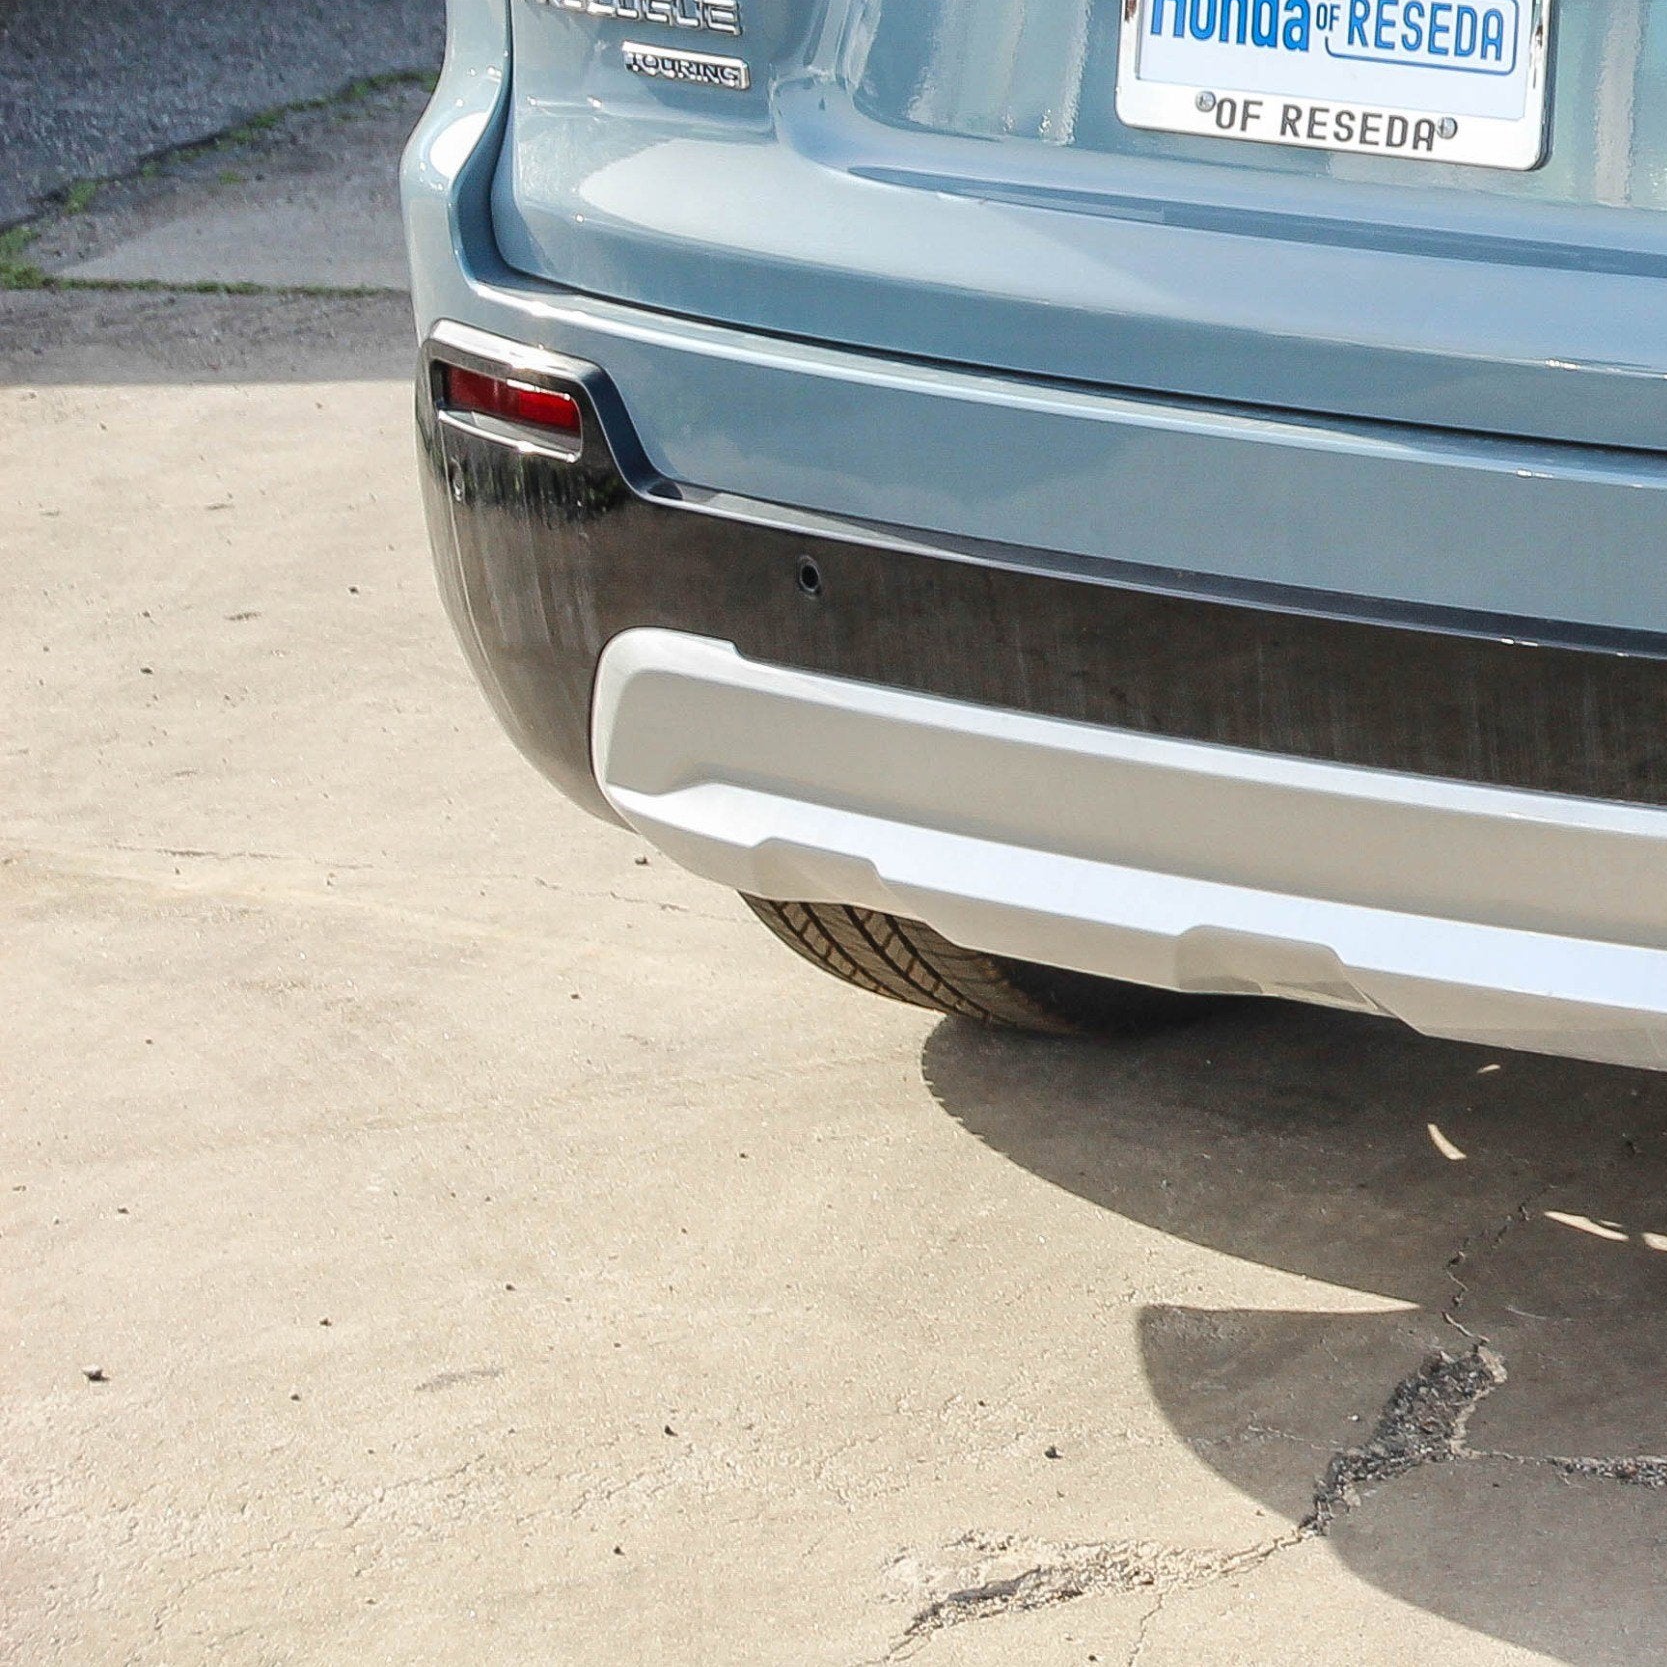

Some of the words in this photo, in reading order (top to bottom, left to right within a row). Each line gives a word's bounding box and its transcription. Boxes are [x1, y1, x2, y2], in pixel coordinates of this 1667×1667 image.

[1315, 1, 1342, 33] OF
[627, 50, 742, 88] TOURING
[1214, 98, 1264, 132] OF
[1280, 102, 1437, 153] RESEDA
